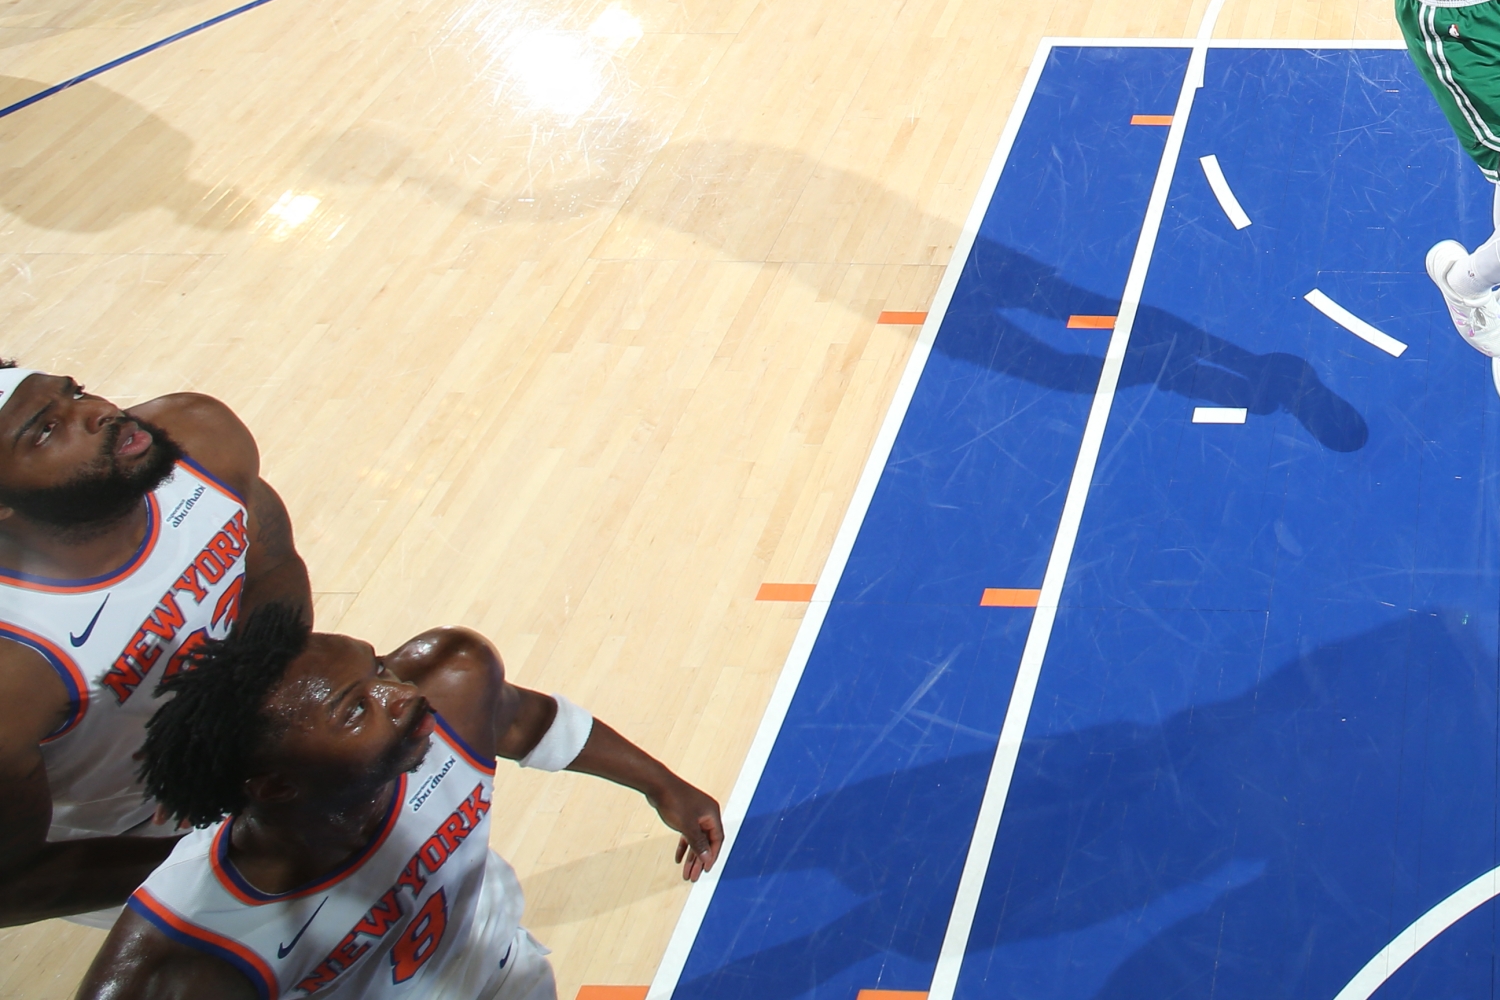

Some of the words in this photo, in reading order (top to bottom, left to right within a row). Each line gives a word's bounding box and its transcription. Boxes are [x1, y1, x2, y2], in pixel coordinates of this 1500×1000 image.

[172, 509, 188, 528] abu
[186, 483, 206, 510] dhabi
[101, 592, 188, 705] NEW
[172, 508, 250, 606] YORK
[414, 789, 431, 812] abu
[430, 755, 456, 789] dhabi
[294, 886, 405, 996] NEW
[397, 782, 492, 900] YORK
[389, 885, 448, 986] 8
